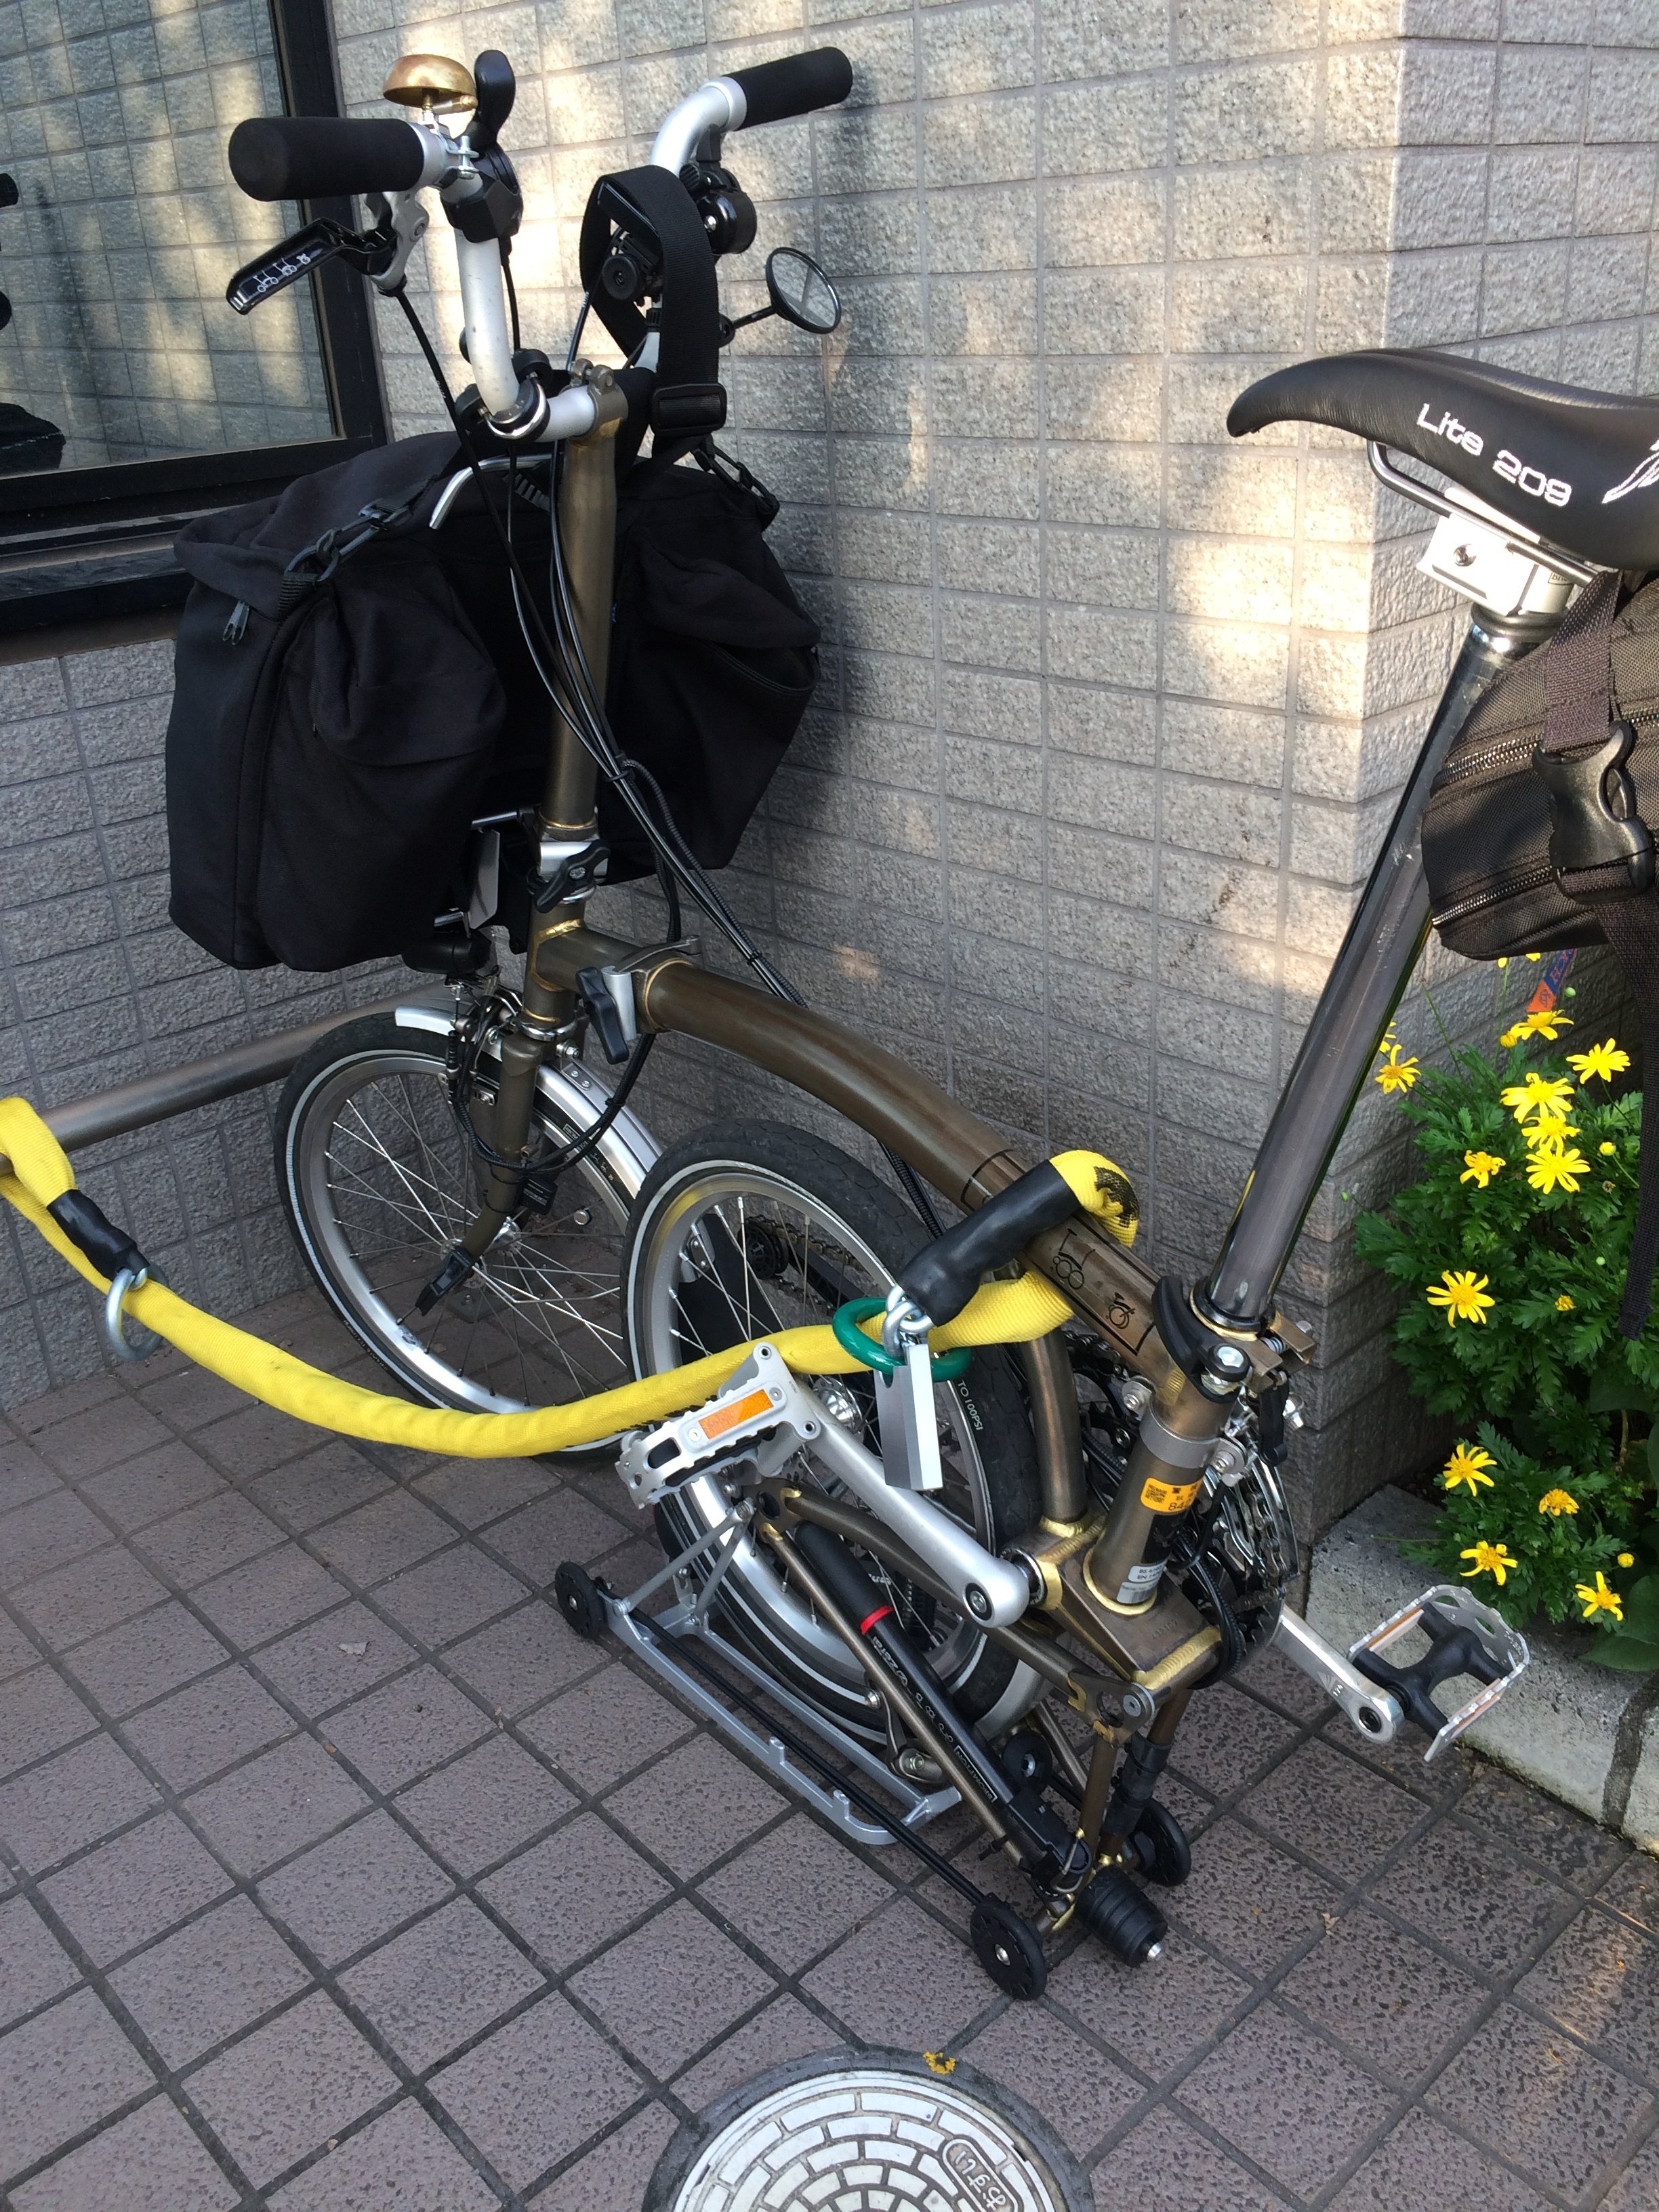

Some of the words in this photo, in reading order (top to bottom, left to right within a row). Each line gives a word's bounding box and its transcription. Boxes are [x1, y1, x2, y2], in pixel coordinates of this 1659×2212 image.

[1416, 403, 1483, 456] Lite
[958, 1378, 969, 1397] TO
[964, 1399, 983, 1431] 100PSI
[955, 2150, 1006, 2211] おすい
